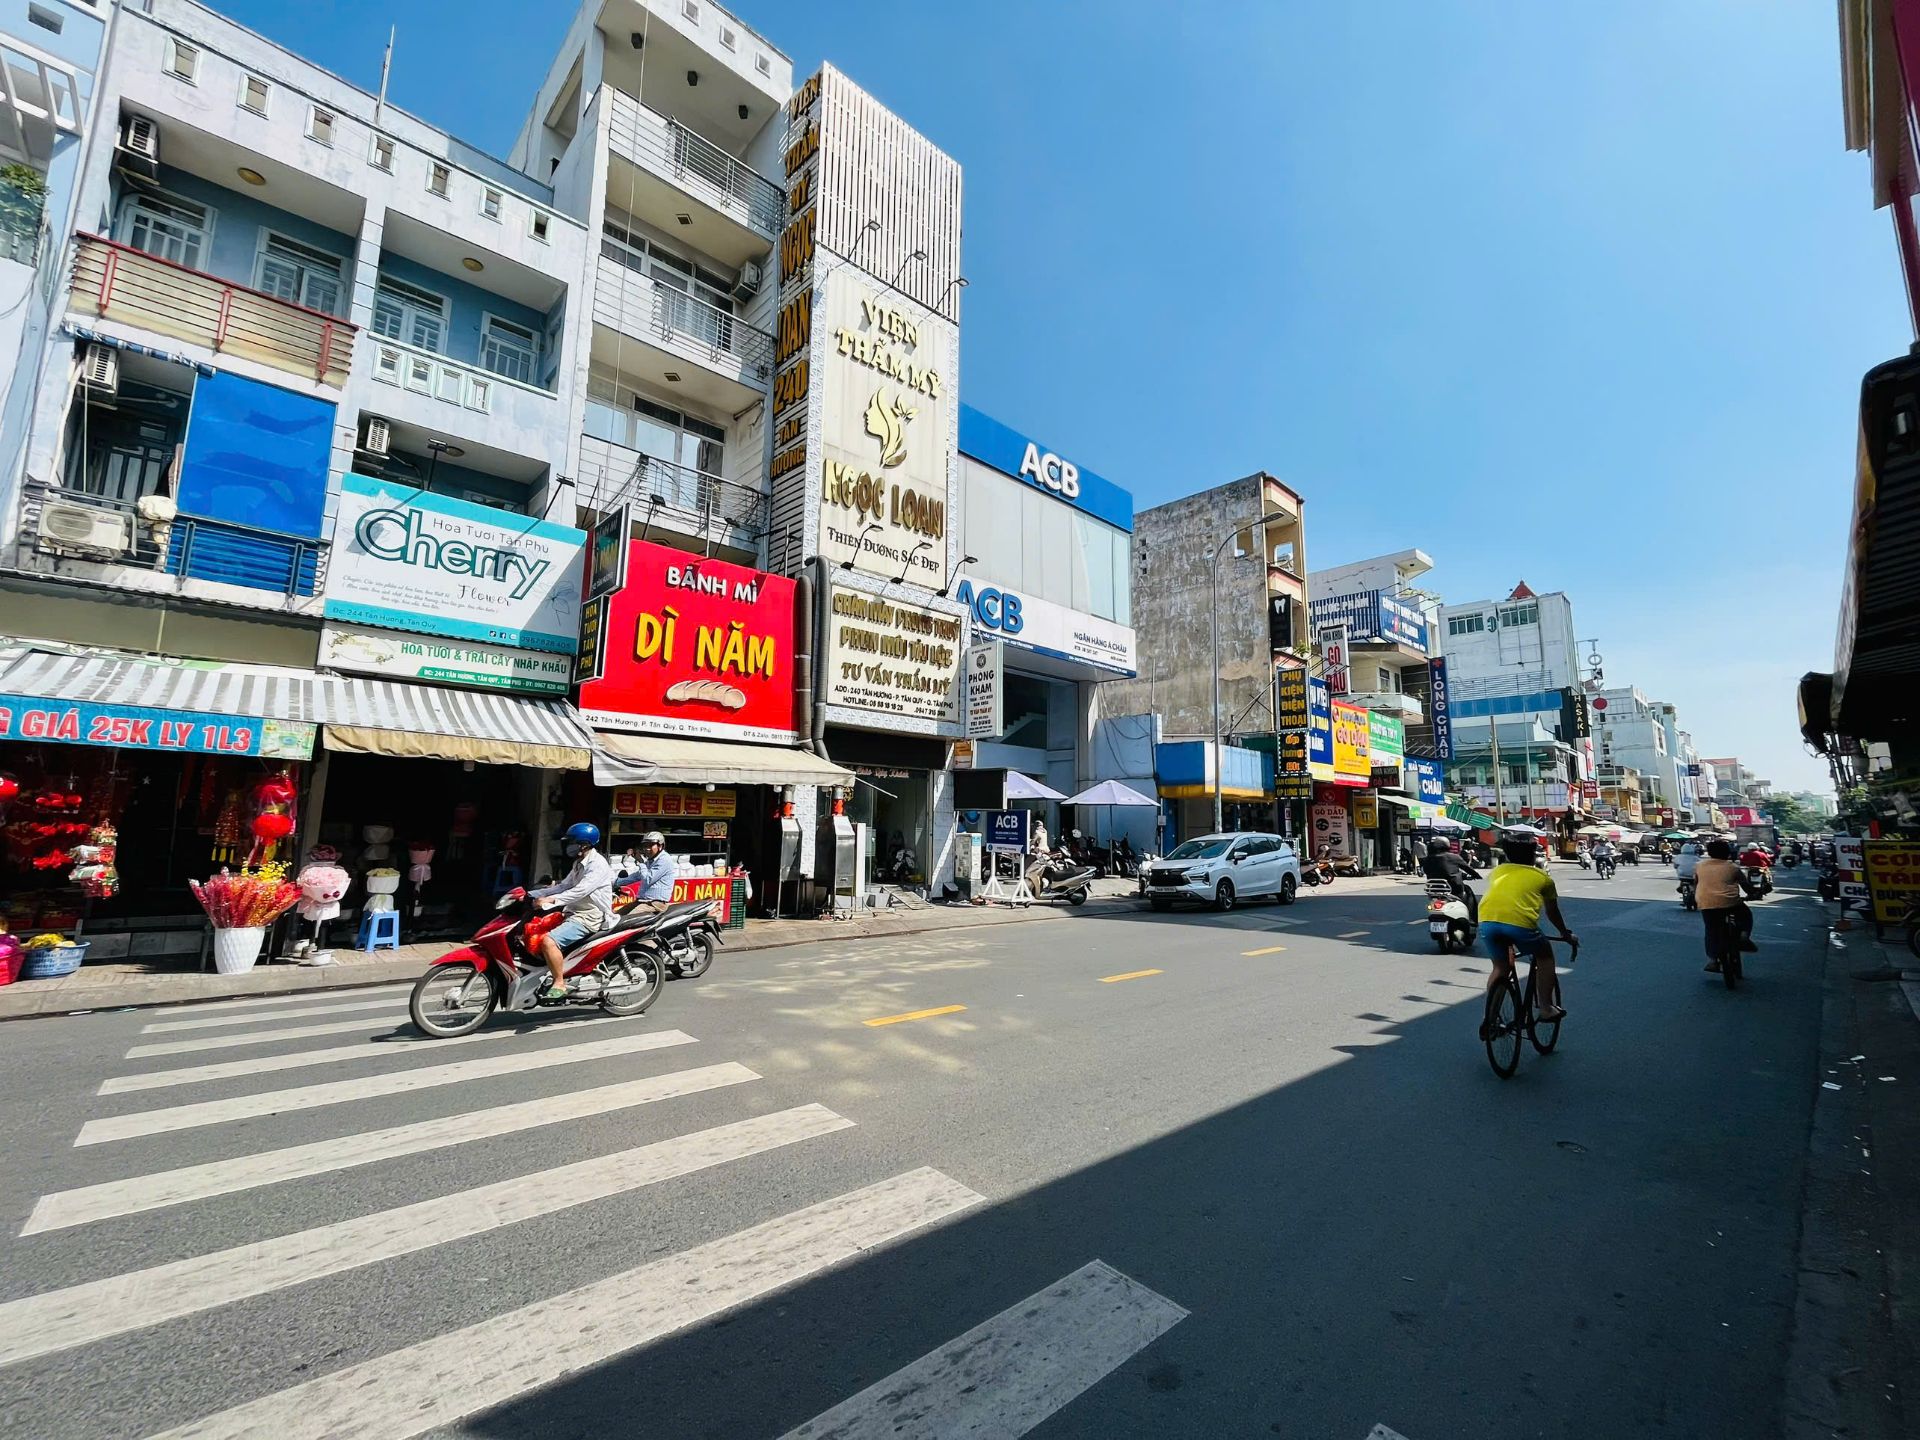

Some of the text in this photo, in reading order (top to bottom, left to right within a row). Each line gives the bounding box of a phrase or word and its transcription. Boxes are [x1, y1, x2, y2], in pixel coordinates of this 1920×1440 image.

[780, 208, 816, 288] NGỌC
[776, 288, 813, 365] LOAN
[861, 298, 917, 347] VIỆN
[834, 327, 941, 401] THẨM MỸ
[774, 360, 808, 417] 240
[1018, 442, 1080, 499] ACB
[823, 458, 944, 541] NGỌC LOAN
[433, 518, 461, 534] Hoa
[355, 508, 551, 600] Cherry
[864, 538, 899, 562] ĐƯỜNG
[457, 583, 512, 606] Flower
[734, 579, 757, 603] MÌ
[347, 608, 362, 617] 244
[585, 603, 597, 619] HOA
[956, 579, 1024, 635] ACB
[636, 605, 776, 679] DÌ NĂM
[1328, 641, 1340, 666] GÒ
[401, 642, 423, 657] HOA
[428, 645, 451, 660] TƯƠI
[454, 650, 462, 661] &
[465, 649, 489, 664] TRÁI
[513, 658, 540, 671] NHẬP
[542, 658, 567, 674] KHẨU
[446, 671, 457, 679] TÂN
[477, 675, 488, 683] TÂN
[841, 661, 864, 681] TƯ
[864, 661, 893, 687] VẤN
[1282, 670, 1302, 682] PHỤ
[850, 686, 861, 695] 240
[861, 687, 873, 697] TÂN
[1281, 684, 1304, 697] KIỆN
[1281, 699, 1305, 712] ĐIỆN
[1433, 670, 1448, 758] LONG CHÂU
[1574, 694, 1584, 737] HASAKI
[20, 707, 80, 740] GIÁ
[89, 715, 152, 747] 25K
[159, 720, 195, 748] LY
[202, 724, 252, 752] 1L3
[586, 714, 599, 723] 242
[1281, 714, 1307, 727] THOẠI
[1422, 777, 1442, 795] CHÂU
[995, 815, 1018, 829] ACB
[673, 880, 726, 902] DÌ NĂM
